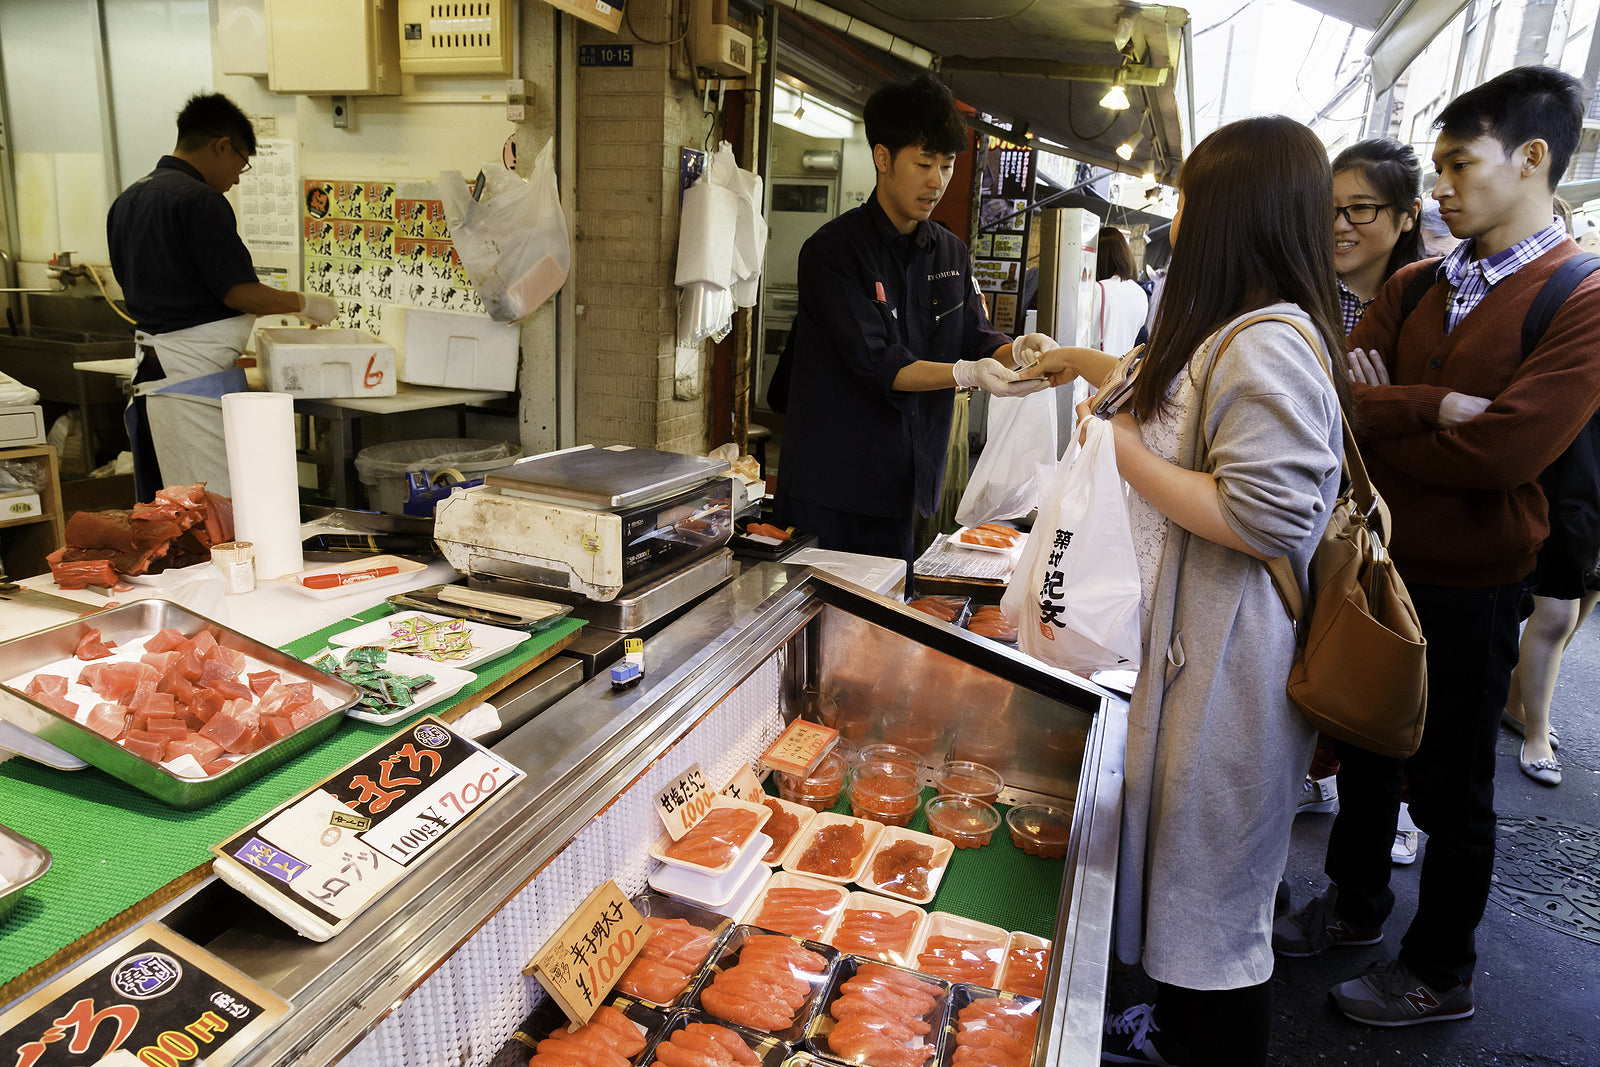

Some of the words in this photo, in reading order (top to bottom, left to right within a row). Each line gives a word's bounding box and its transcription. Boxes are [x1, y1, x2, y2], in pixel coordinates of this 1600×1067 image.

[601, 49, 630, 62] 10-15
[364, 353, 384, 389] 6
[1048, 529, 1074, 568] 築地
[1038, 570, 1066, 629] 紀文
[660, 770, 706, 813] 甘塩たらこ
[722, 784, 741, 800] 子
[334, 815, 366, 828] 中トロ
[247, 844, 304, 881] 極上
[551, 961, 571, 989] 博多
[569, 900, 623, 967] 辛子明太子
[209, 991, 250, 1019] (税込)
[1404, 986, 1440, 1015] N
